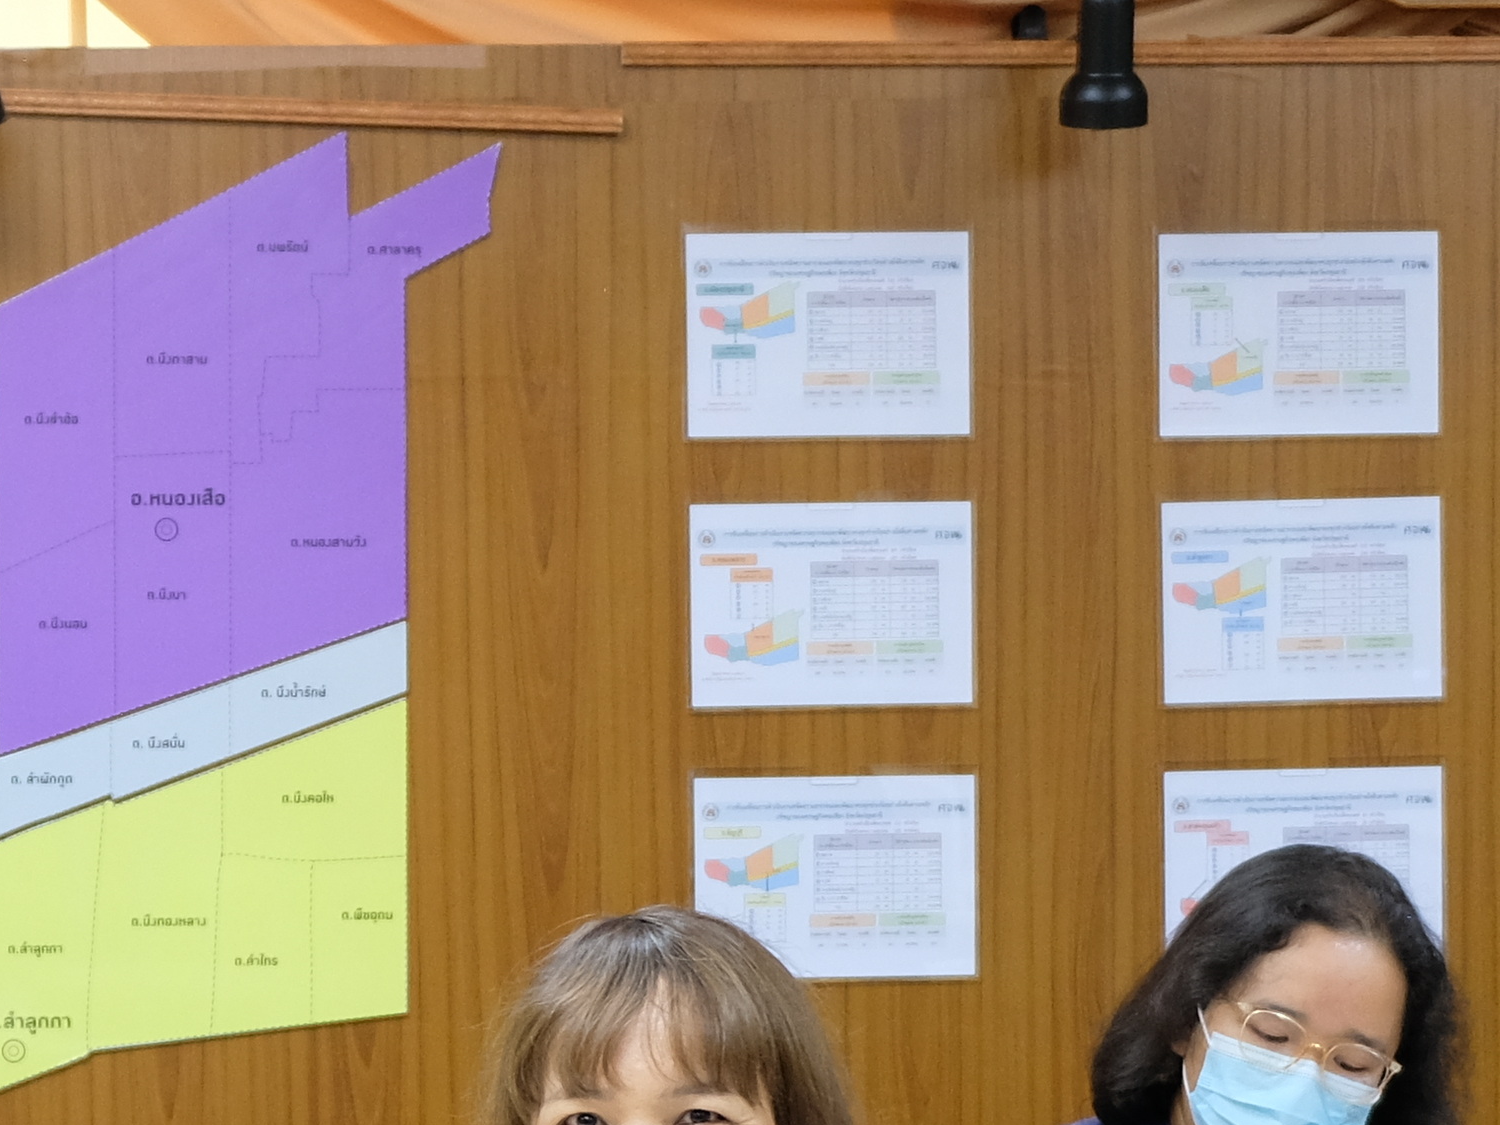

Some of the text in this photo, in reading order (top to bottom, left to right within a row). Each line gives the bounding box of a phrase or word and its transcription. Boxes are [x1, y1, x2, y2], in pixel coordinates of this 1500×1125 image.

[367, 244, 422, 258] ต.ศาลาครุ
[146, 352, 208, 365] ต.บึงกาสาม
[130, 487, 226, 507] อ.หนองเสือ
[290, 535, 367, 548] ต.หนองสามวัง
[281, 791, 335, 805] ต.บึงคอไห
[130, 915, 208, 928] ต.บึงทองหลาง
[7, 942, 64, 958] ต.ลำลูกกา
